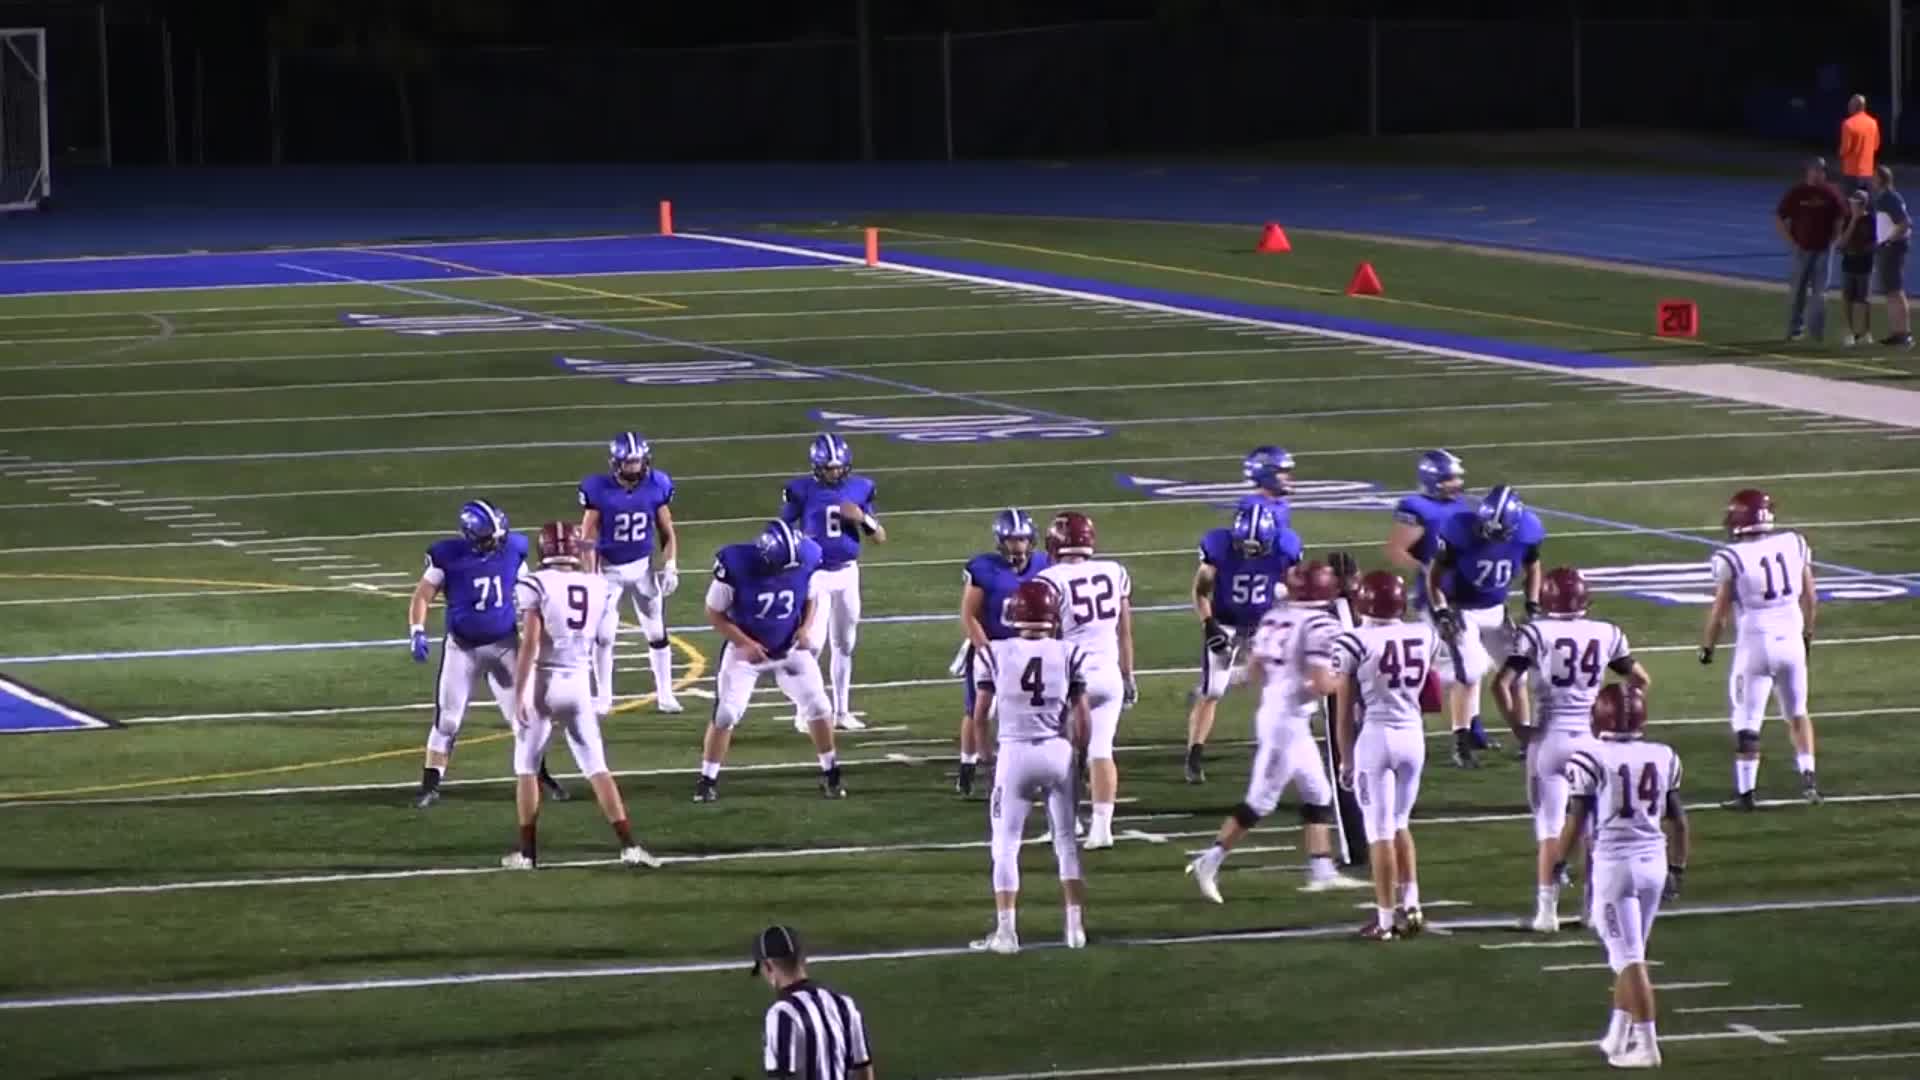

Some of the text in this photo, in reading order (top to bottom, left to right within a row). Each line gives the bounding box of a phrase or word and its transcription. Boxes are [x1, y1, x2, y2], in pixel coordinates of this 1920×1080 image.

[1663, 305, 1690, 333] 20
[613, 511, 648, 541] 22
[473, 576, 504, 611] 71
[1232, 574, 1269, 604] 52
[1474, 559, 1513, 588] 70
[1759, 552, 1793, 600] 11
[566, 585, 589, 630] 9
[754, 590, 795, 619] 73
[1068, 574, 1117, 625] 52
[1020, 656, 1046, 707] 4
[1378, 638, 1425, 689] 45
[1551, 637, 1601, 687] 34
[1617, 761, 1661, 819] 14
